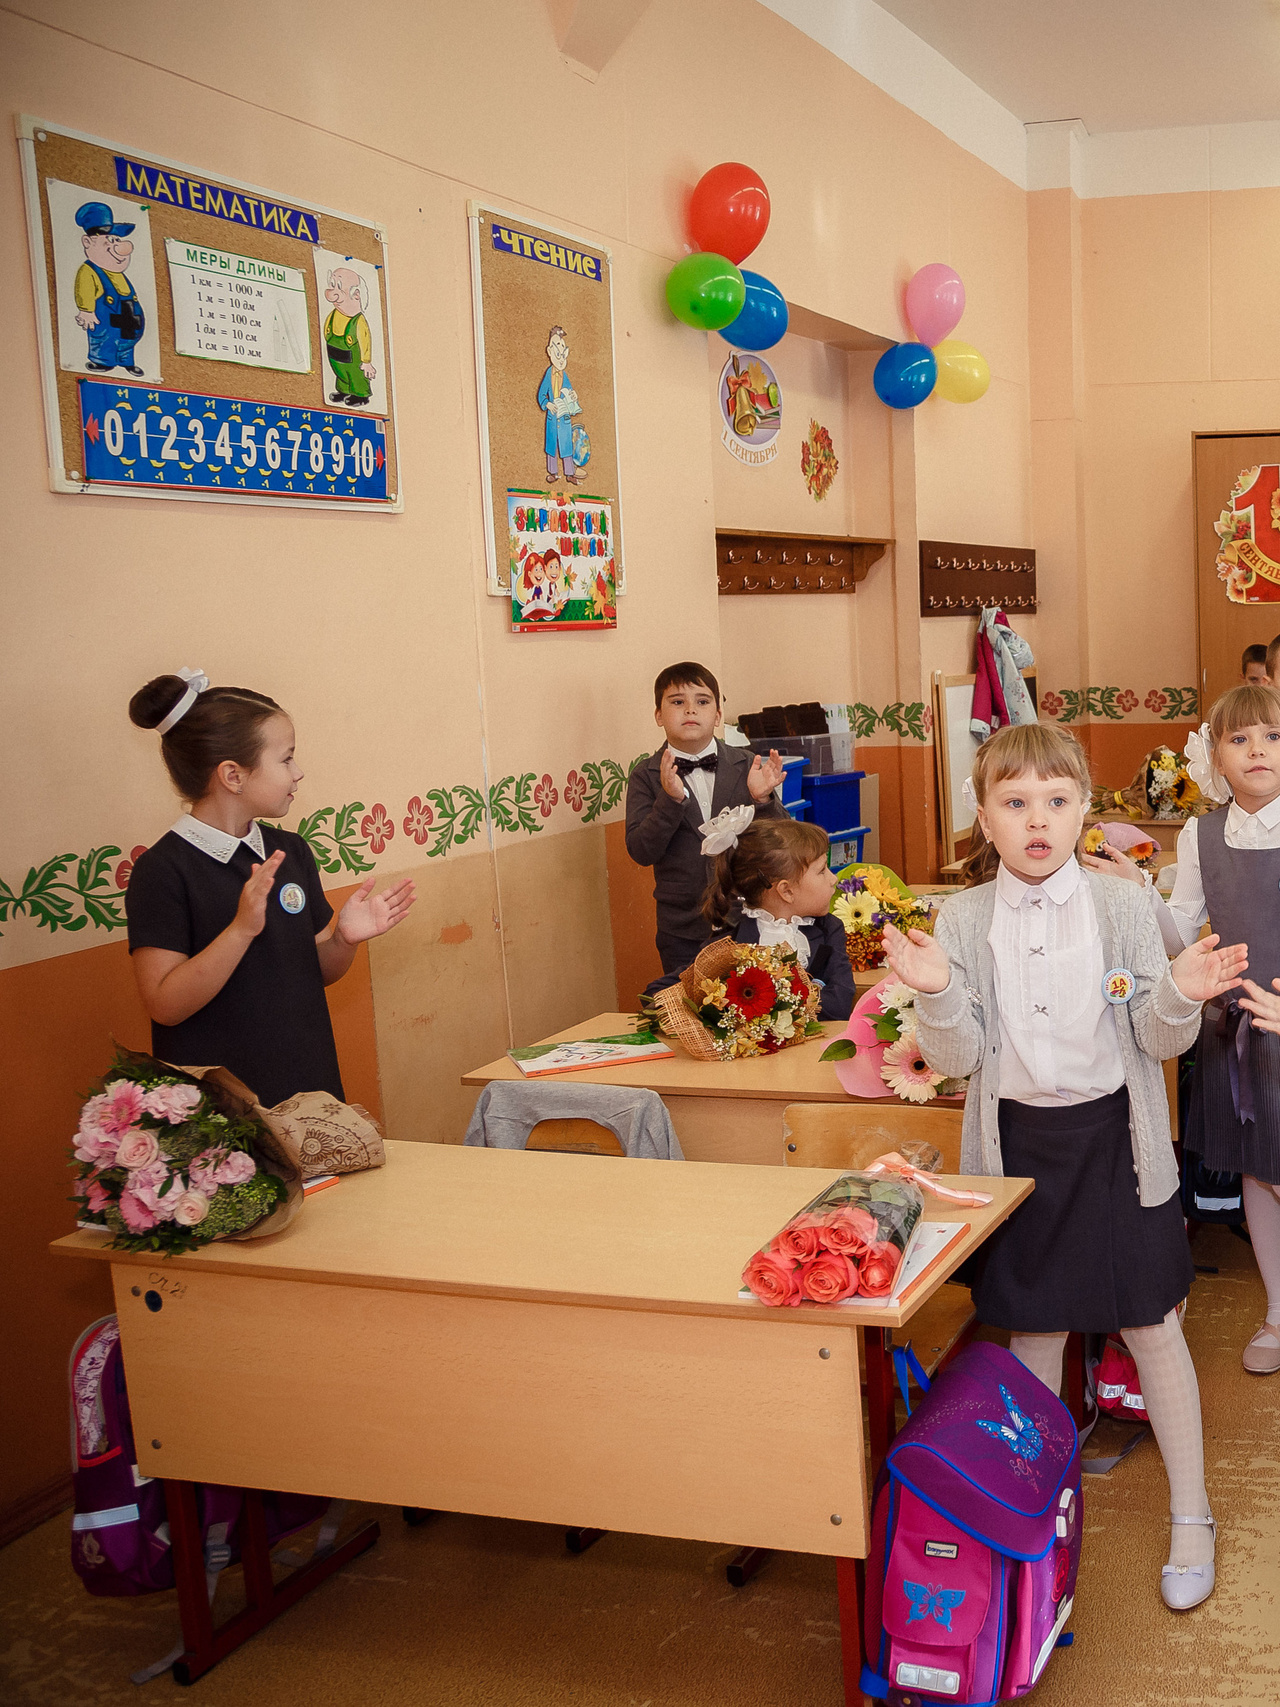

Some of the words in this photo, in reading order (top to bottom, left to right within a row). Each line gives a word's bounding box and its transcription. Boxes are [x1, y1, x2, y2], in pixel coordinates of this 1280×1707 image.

[126, 162, 314, 242] МАТЕМАТИКА
[186, 248, 230, 270] МЕРЫ
[236, 260, 286, 282] ДЛИНЫ
[190, 274, 196, 284] 1
[199, 278, 212, 287] км
[255, 289, 263, 298] м
[197, 291, 202, 301] 1
[205, 295, 213, 304] м
[230, 298, 240, 309] 10
[243, 300, 255, 311] дм
[198, 307, 204, 318] 1
[207, 311, 215, 319] м
[231, 313, 247, 325] 100
[250, 319, 261, 328] см
[195, 322, 200, 332] 1
[203, 323, 216, 335] дм
[232, 329, 243, 340] 10
[245, 333, 257, 342] см
[197, 339, 202, 349] 1
[205, 342, 217, 351] см
[234, 345, 245, 356] 10
[247, 349, 262, 358] мм
[117, 389, 128, 398] +1
[148, 393, 159, 402] +1
[177, 397, 188, 406] +1
[205, 400, 215, 409] +1
[231, 403, 241, 412] +1
[256, 407, 265, 415] +1
[281, 410, 290, 418] +1
[302, 413, 311, 421] +1
[324, 416, 332, 424] +1
[346, 419, 353, 427] +1
[104, 409, 124, 456] 0
[132, 412, 148, 458] 1
[160, 416, 180, 460] 2
[188, 418, 206, 463] 3
[214, 422, 233, 465] 4
[241, 425, 257, 468] 5
[265, 428, 281, 470] 6
[287, 430, 302, 471] 7
[309, 433, 324, 473] 8
[331, 435, 344, 475] 9
[351, 438, 374, 478] 10
[729, 438, 778, 464] СЕНТЯБРЯ
[125, 470, 134, 479] -1
[155, 472, 164, 481] -1
[184, 474, 193, 483] -1
[212, 476, 220, 484] -1
[238, 478, 246, 486] -1
[262, 480, 269, 488] -1
[285, 482, 293, 490] -1
[306, 483, 313, 492] -1
[328, 485, 335, 493] -1
[560, 536, 607, 557] ШКОЛА!
[1112, 977, 1127, 989] 1А
